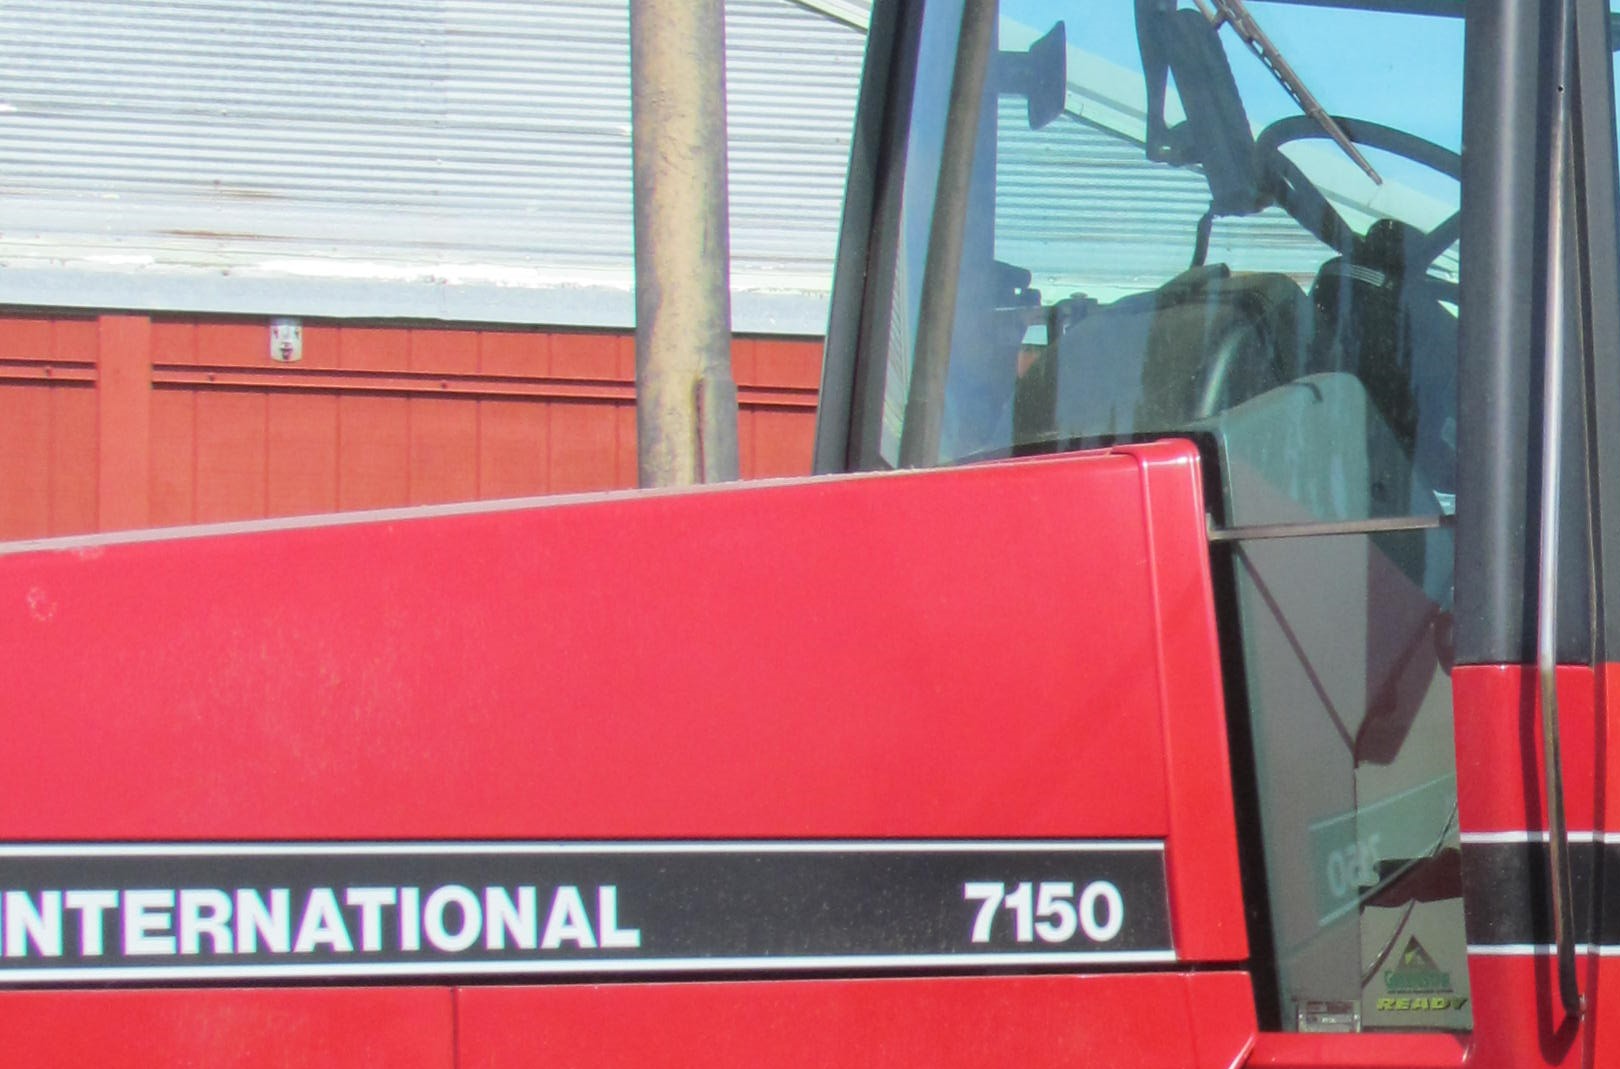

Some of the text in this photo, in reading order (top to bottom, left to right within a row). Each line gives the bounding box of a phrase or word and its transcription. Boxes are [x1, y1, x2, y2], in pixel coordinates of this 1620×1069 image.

[0, 885, 641, 957] NTERNATIONAL
[963, 880, 1124, 943] 7150
[1376, 997, 1468, 1011] READY
